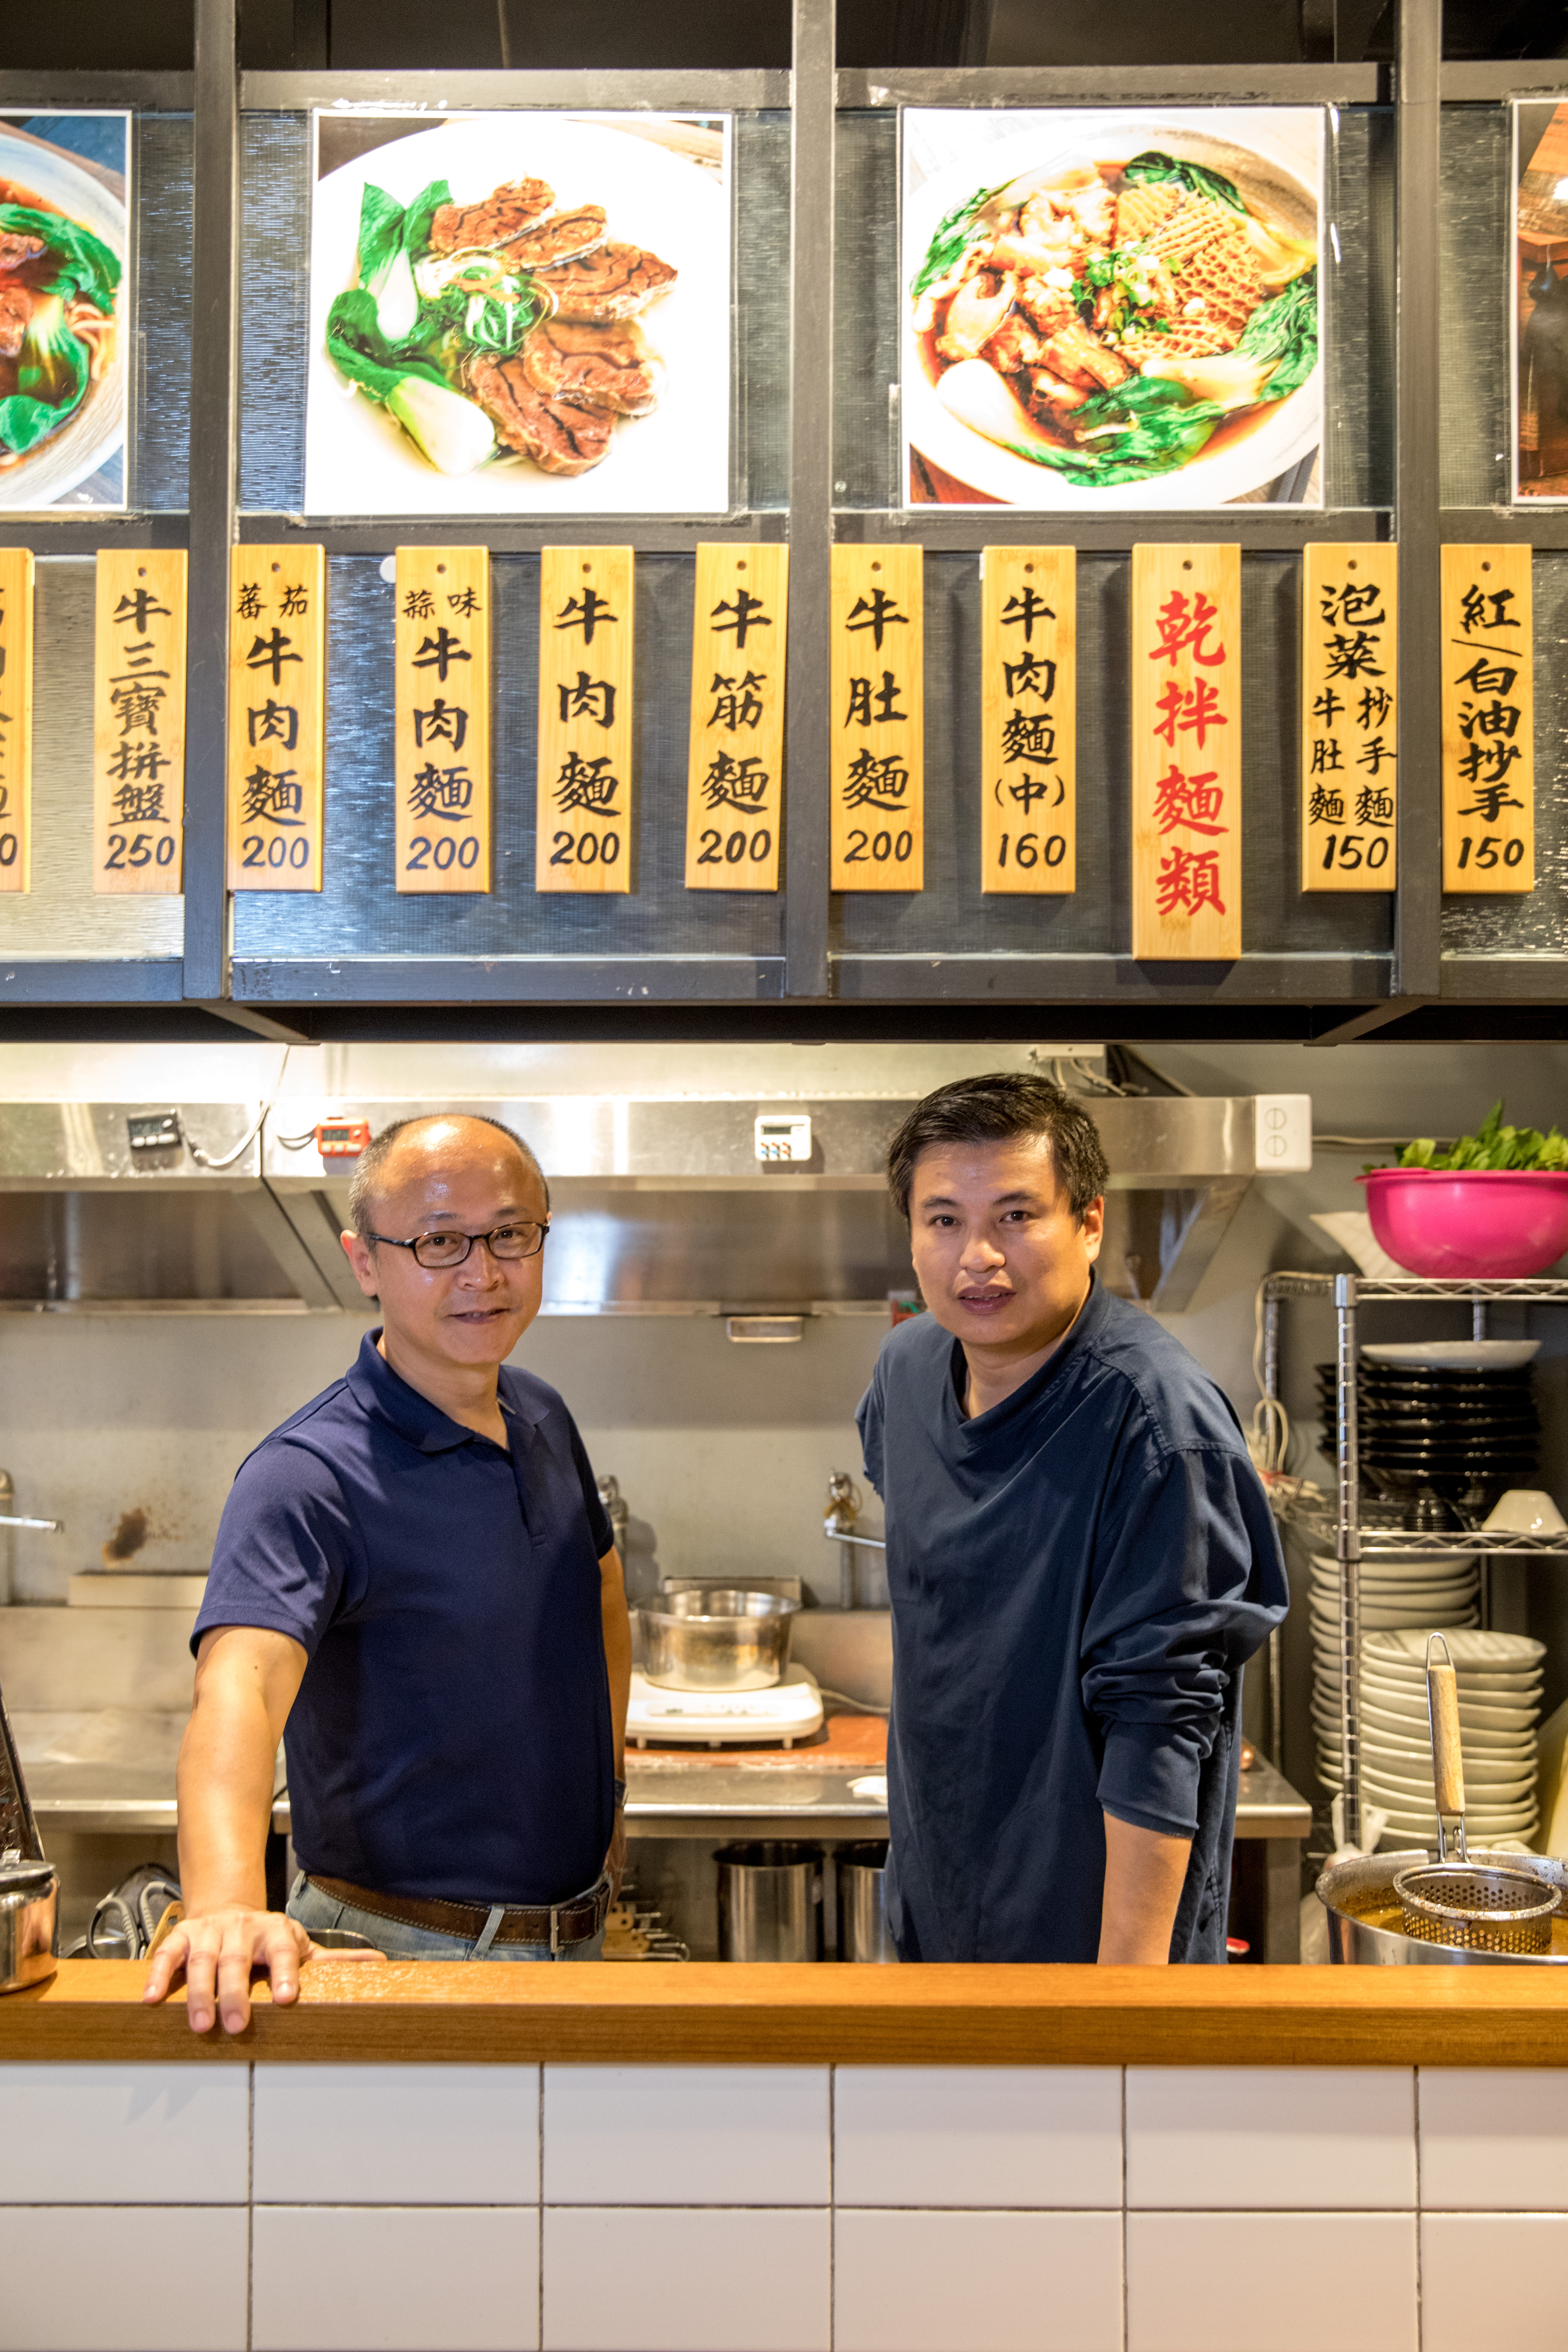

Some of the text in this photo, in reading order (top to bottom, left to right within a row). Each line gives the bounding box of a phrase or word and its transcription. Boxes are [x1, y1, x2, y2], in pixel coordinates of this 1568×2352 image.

[235, 583, 309, 619] 蕃茄
[402, 587, 482, 619] 蒜味
[1320, 583, 1386, 680] 泡菜
[107, 588, 172, 826] 牛三寶拼盤
[553, 587, 621, 817] 牛肉麵
[701, 589, 772, 814] 牛筋麵
[843, 588, 910, 812] 牛肚麵
[242, 626, 304, 827] 牛肉麵
[407, 626, 473, 821] 牛肉麵
[1149, 590, 1229, 916] 乾拌麵類
[1309, 687, 1346, 826] 牛肚麵
[1355, 686, 1396, 828] 抄手麵
[103, 834, 175, 870] 250
[242, 835, 309, 869] 200
[406, 836, 479, 870] 200
[549, 830, 620, 865] 200
[697, 829, 772, 864] 200
[843, 829, 913, 863] 200
[998, 833, 1066, 869] 160
[1322, 834, 1389, 870] 150
[1457, 836, 1525, 869] 150
